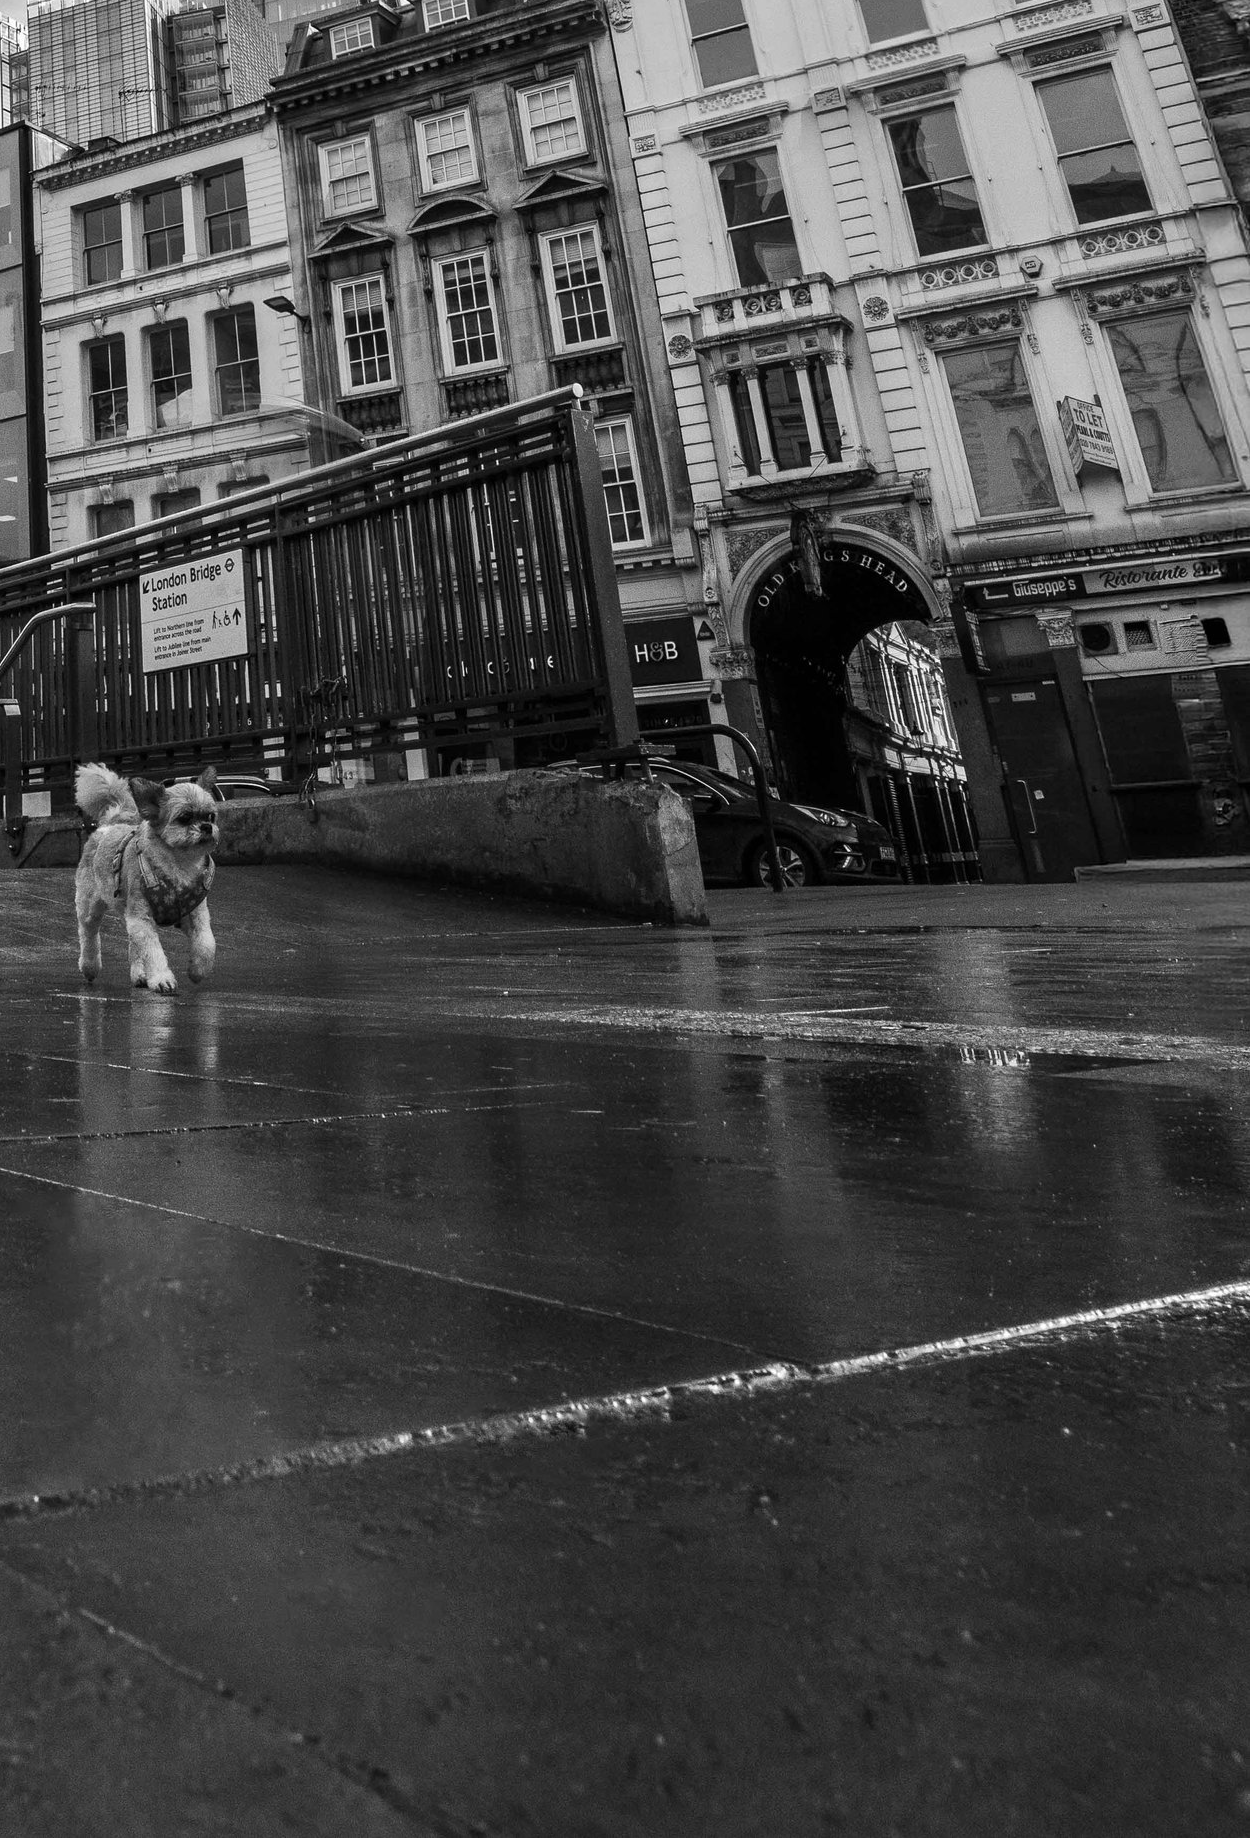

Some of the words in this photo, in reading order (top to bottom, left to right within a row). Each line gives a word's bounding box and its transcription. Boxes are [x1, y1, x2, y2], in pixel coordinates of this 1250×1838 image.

[1073, 408, 1085, 423] TO
[1086, 413, 1103, 428] LET
[152, 573, 187, 592] London
[190, 563, 221, 582] Bridge
[757, 573, 785, 607] OLD
[790, 550, 849, 574] KGS
[859, 555, 908, 593] HEAD
[1012, 578, 1077, 597] Giuseppe's
[1099, 565, 1188, 588] Ristorante
[152, 593, 187, 611] Station
[167, 623, 185, 631] Northern
[154, 634, 170, 642] entrance
[190, 646, 202, 654] Street
[634, 641, 678, 662] H&B
